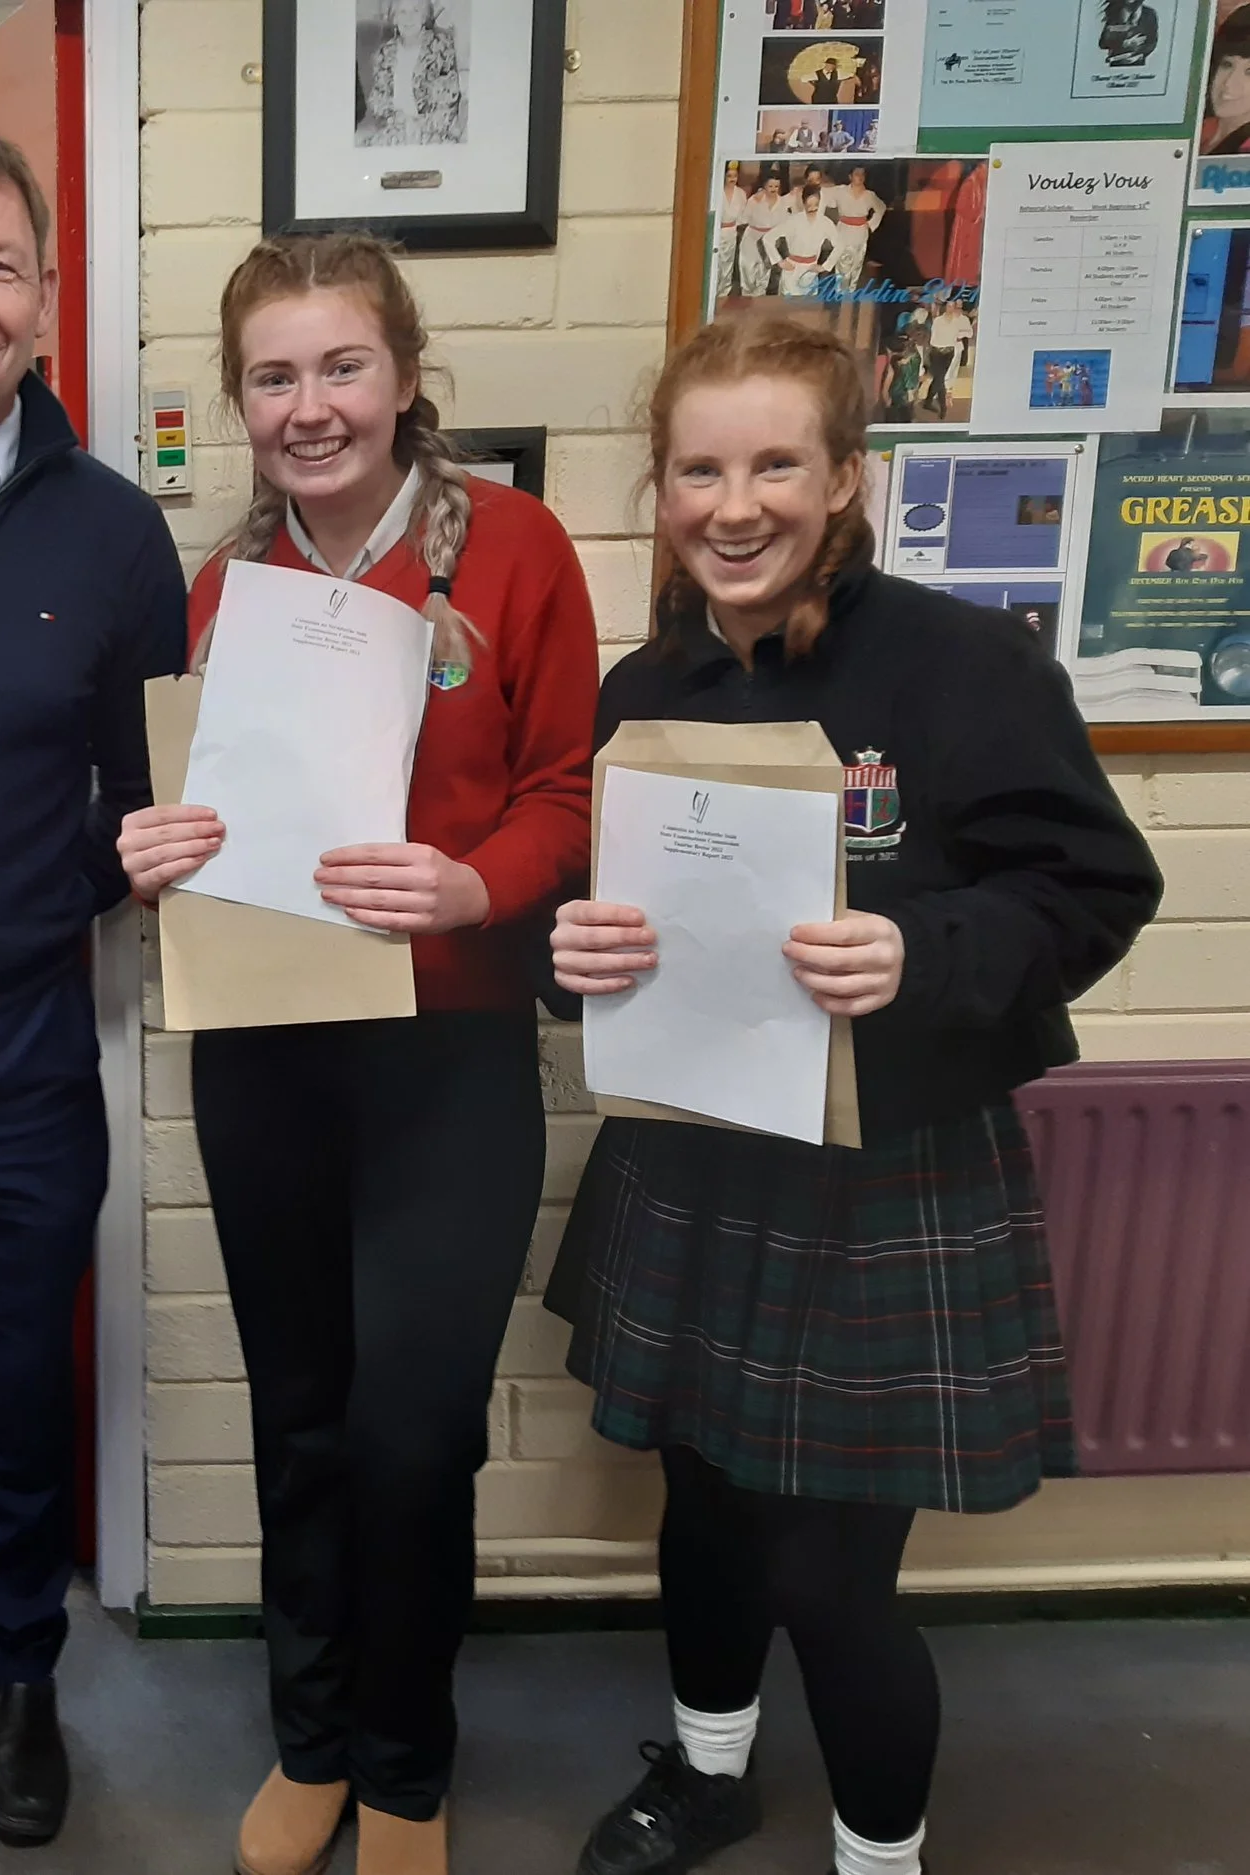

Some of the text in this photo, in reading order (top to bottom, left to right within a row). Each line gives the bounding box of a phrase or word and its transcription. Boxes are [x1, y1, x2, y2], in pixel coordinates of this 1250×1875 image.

[1028, 171, 1153, 195] Voulez Vous
[1122, 475, 1154, 483] SACRED
[1186, 474, 1233, 482] SECONDARY
